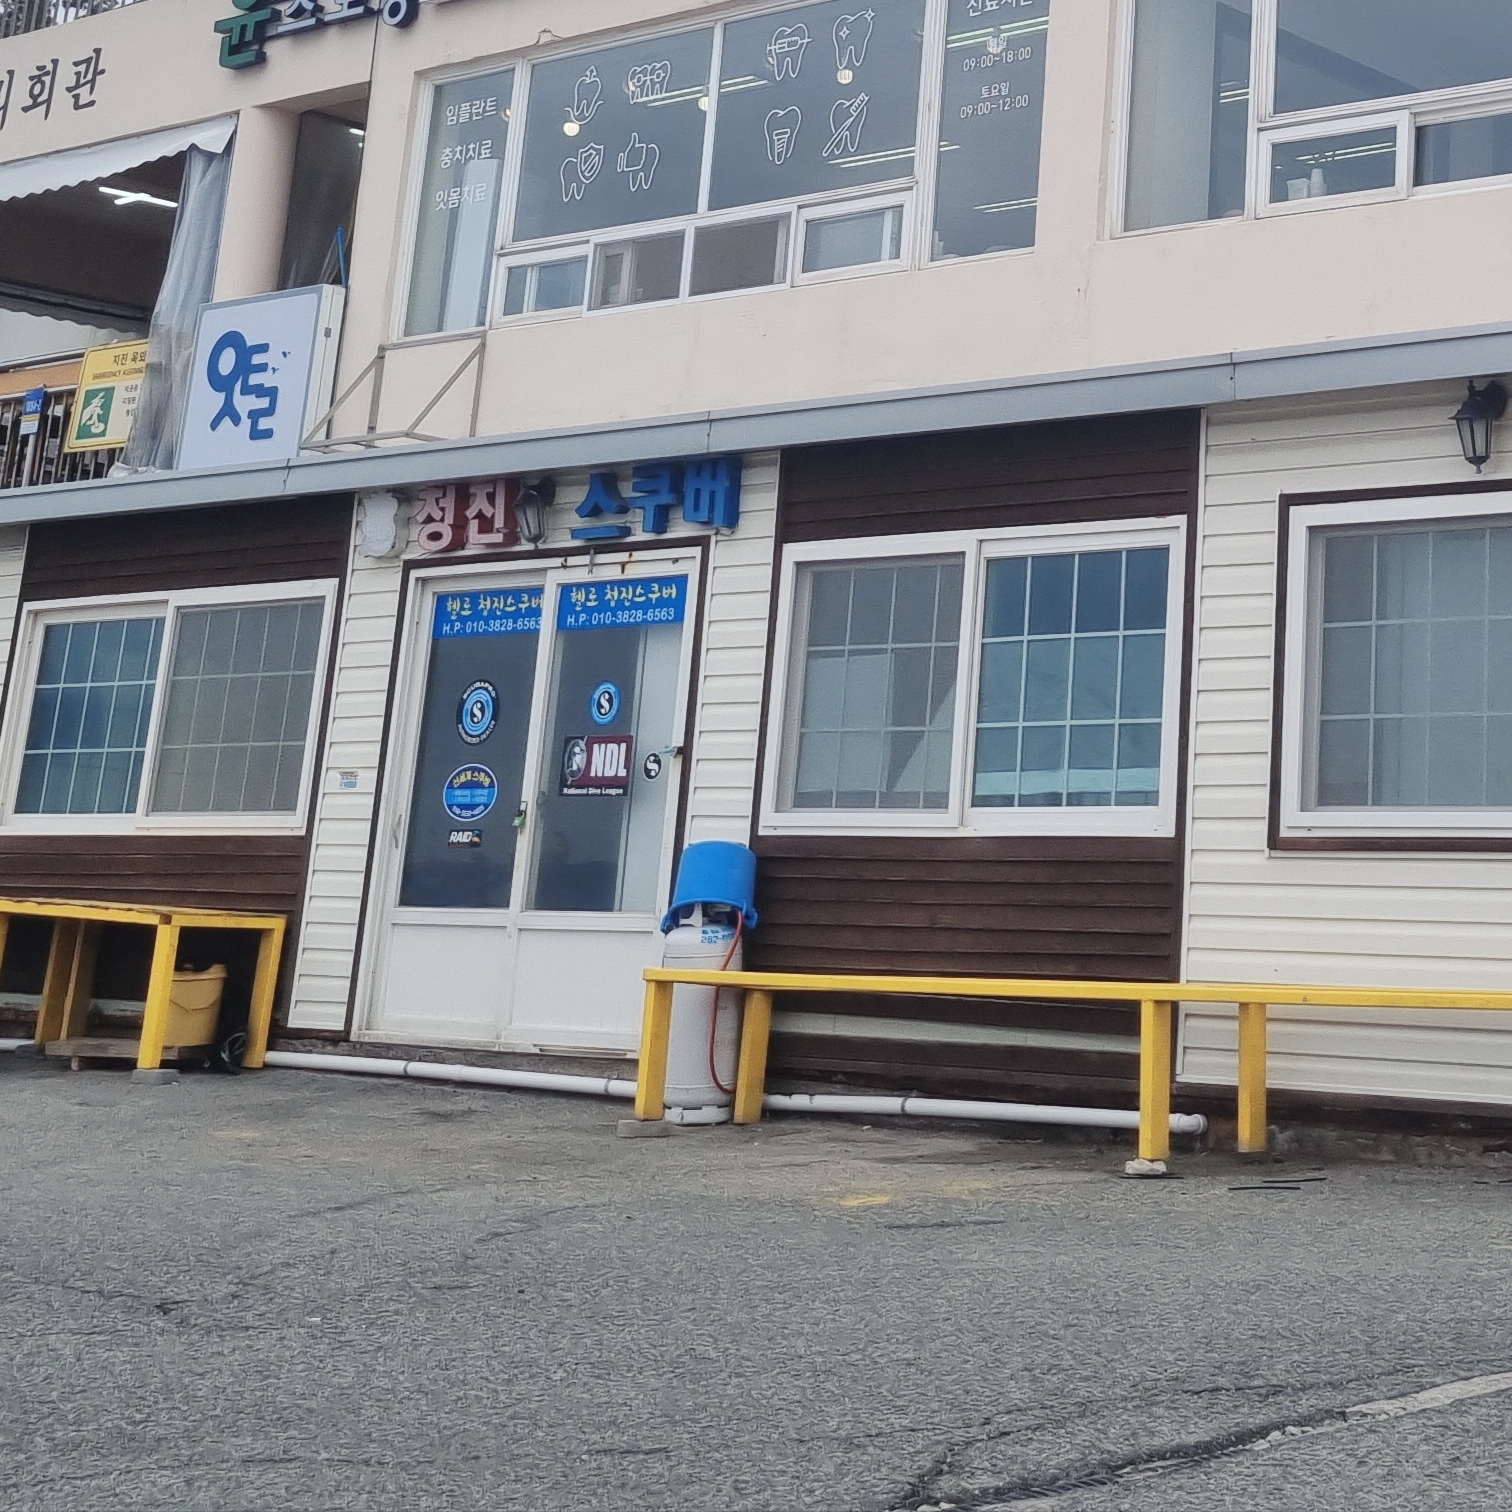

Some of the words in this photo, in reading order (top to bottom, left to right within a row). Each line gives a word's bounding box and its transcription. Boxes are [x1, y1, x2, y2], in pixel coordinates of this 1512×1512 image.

[963, 46, 1032, 72] 09:00~18:00
[980, 81, 1010, 99] 토요일
[446, 96, 497, 126] 임플란트
[960, 94, 1029, 119] 09:00~12:00
[440, 139, 492, 169] 충치치료
[435, 182, 487, 211] 잇몸치료
[570, 455, 742, 540] 스쿠버
[570, 586, 599, 611] 헬로
[591, 607, 675, 625] 010-3828-6563
[590, 742, 627, 777] NDL
